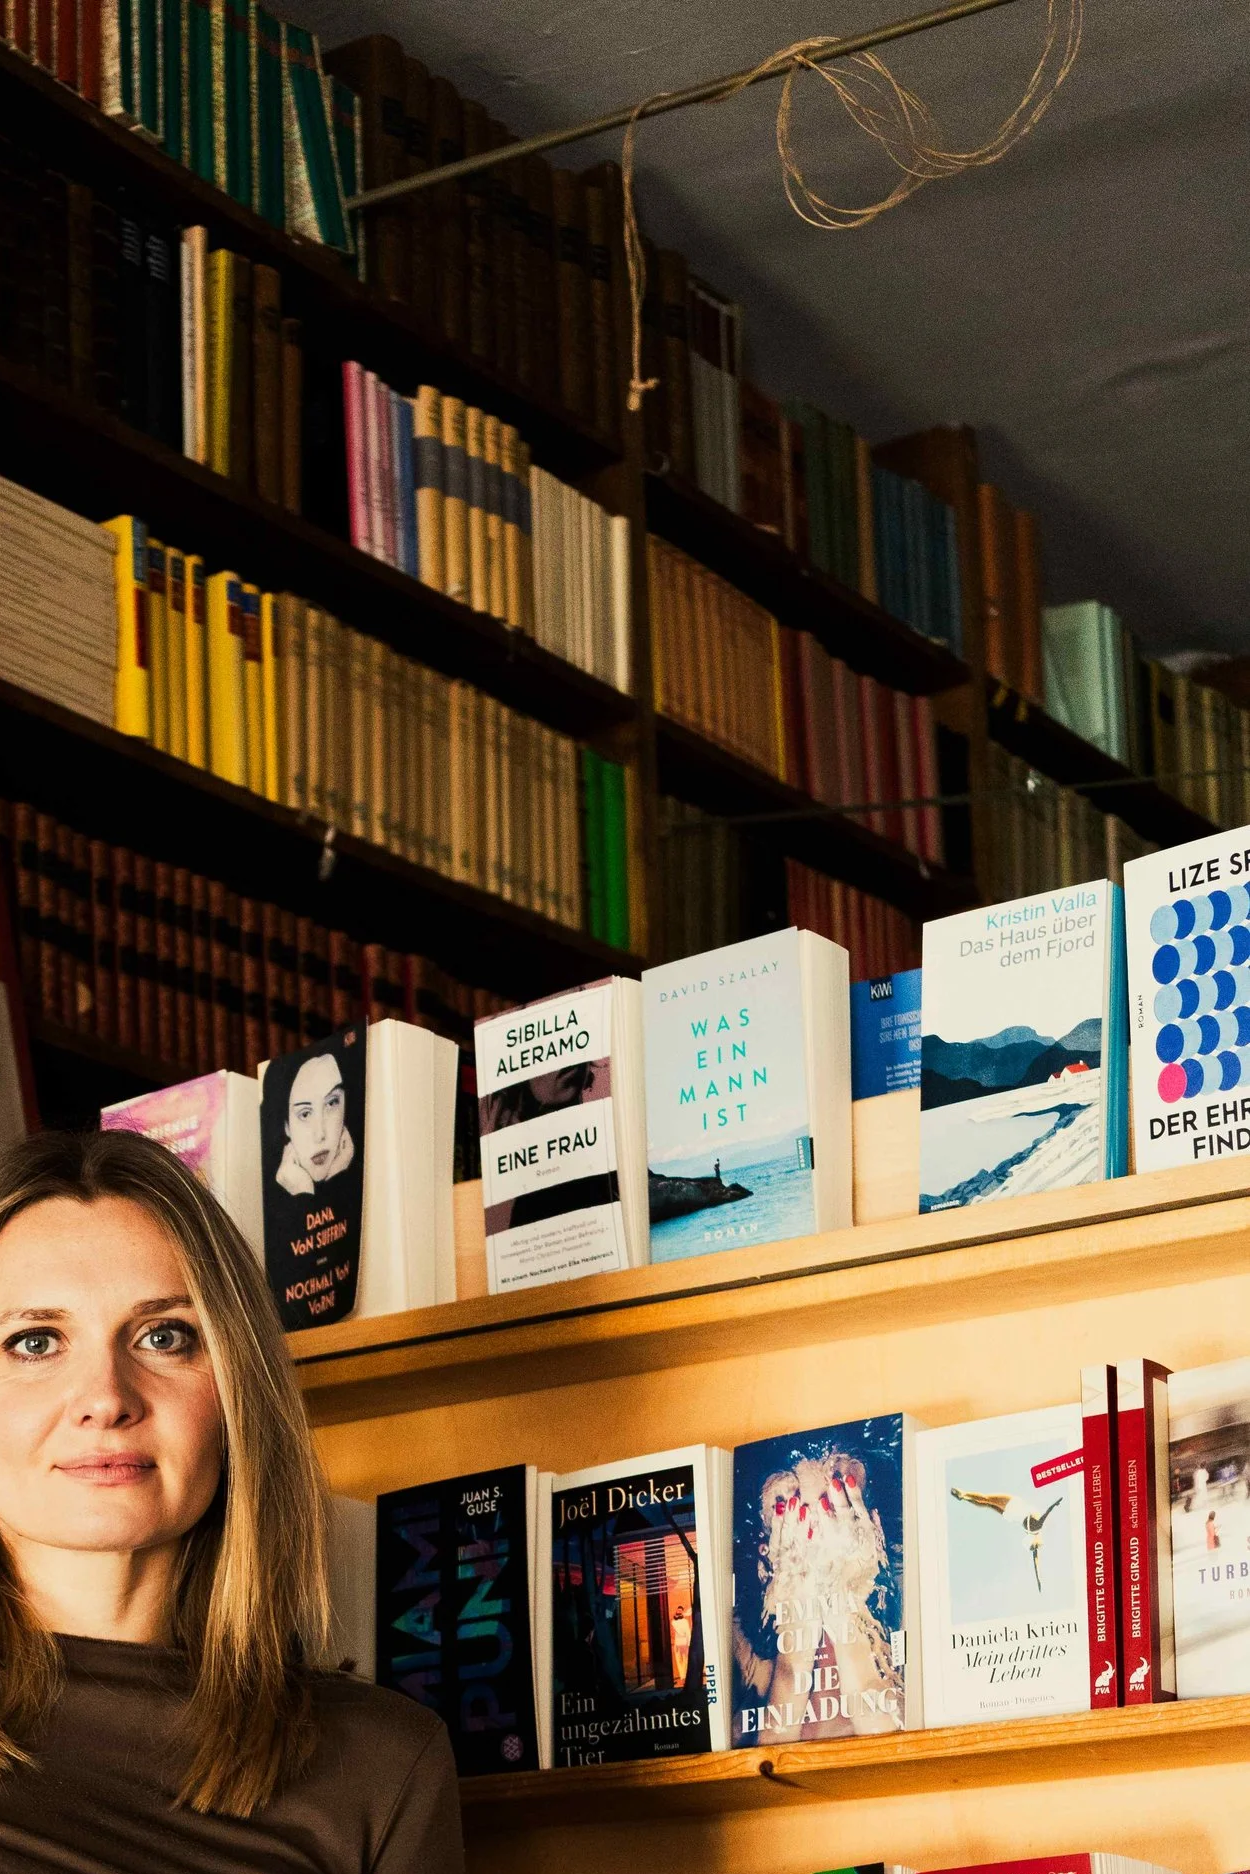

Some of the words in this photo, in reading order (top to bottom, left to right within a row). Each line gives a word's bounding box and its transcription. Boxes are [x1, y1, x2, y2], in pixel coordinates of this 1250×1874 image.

[1169, 858, 1220, 892] LIZE
[987, 904, 1045, 930] Kristin
[1053, 892, 1096, 914] Valla
[960, 939, 993, 957] Das
[1000, 928, 1047, 947] Haus
[1054, 914, 1096, 935] über
[1000, 949, 1041, 967] dem
[1047, 931, 1094, 958] Fjord
[660, 981, 708, 1002] DAVID
[719, 961, 779, 985] SZALAY
[506, 1010, 578, 1047] SIBILLA
[691, 1009, 750, 1038] WAS
[496, 1031, 589, 1076] ALERAMO
[697, 1041, 746, 1069] EIN
[680, 1068, 768, 1104] MANN
[703, 1104, 746, 1129] IST
[1150, 1110, 1197, 1139] DER
[498, 1146, 539, 1174] EINE
[547, 1127, 598, 1159] FRAU
[306, 1207, 334, 1230] DANA
[528, 1264, 555, 1278] Nachwort
[581, 1251, 613, 1263] Heidenreich
[459, 1490, 489, 1505] JUAN
[494, 1486, 502, 1498] S.
[466, 1501, 496, 1516] GUSE
[559, 1492, 596, 1529] Joël
[608, 1480, 685, 1512] Dicker
[1093, 1500, 1102, 1534] schnell
[1095, 1541, 1103, 1586] GIRAUD
[1097, 1589, 1106, 1642] BRIGITTE
[952, 1627, 1019, 1649] Daniela
[1027, 1621, 1077, 1639] Krien
[963, 1652, 1004, 1670] Mein
[1008, 1643, 1066, 1664] drittes
[706, 1666, 716, 1704] PIPER
[794, 1665, 839, 1694] DIE
[990, 1665, 1042, 1684] Leben
[561, 1693, 595, 1715] Ein
[742, 1687, 897, 1734] EINLADUNG
[561, 1706, 700, 1745] ungezähmtes
[654, 1742, 679, 1751] Roman
